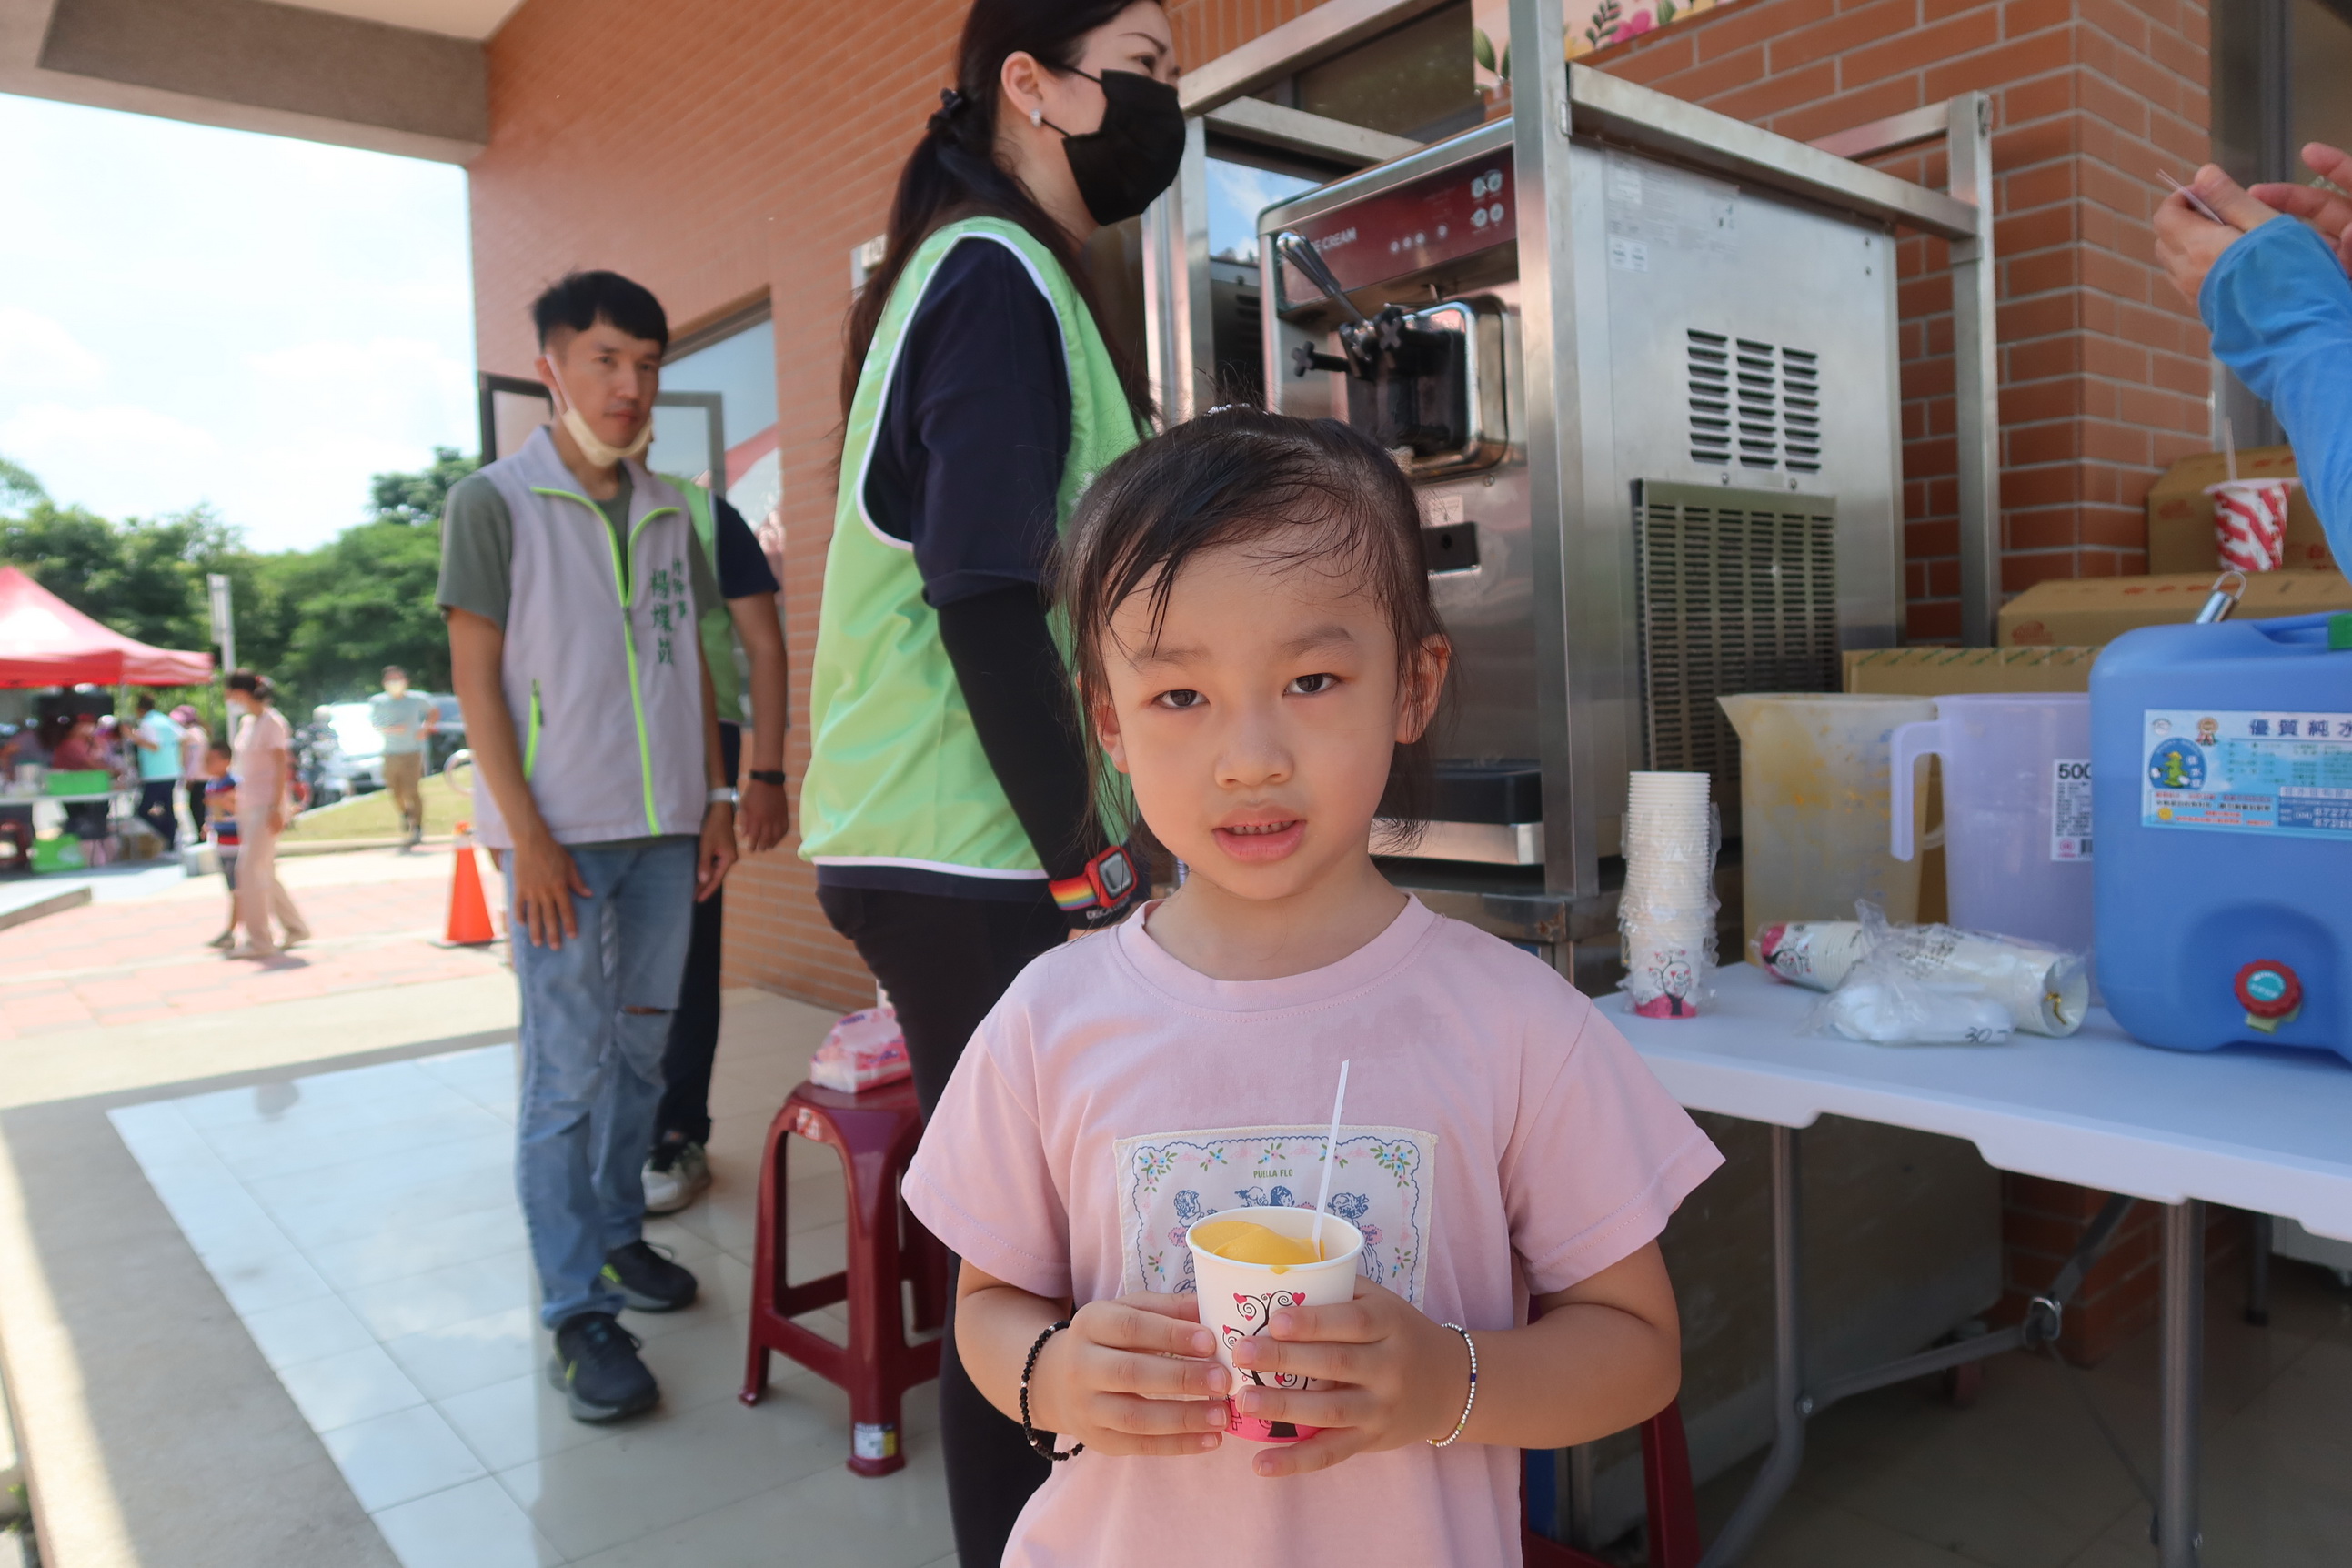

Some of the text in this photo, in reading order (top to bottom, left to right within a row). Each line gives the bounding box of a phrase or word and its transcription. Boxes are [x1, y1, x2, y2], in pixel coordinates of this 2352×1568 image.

[1322, 227, 1357, 250] CREAM
[1253, 1169, 1293, 1179] PUELLA FLO
